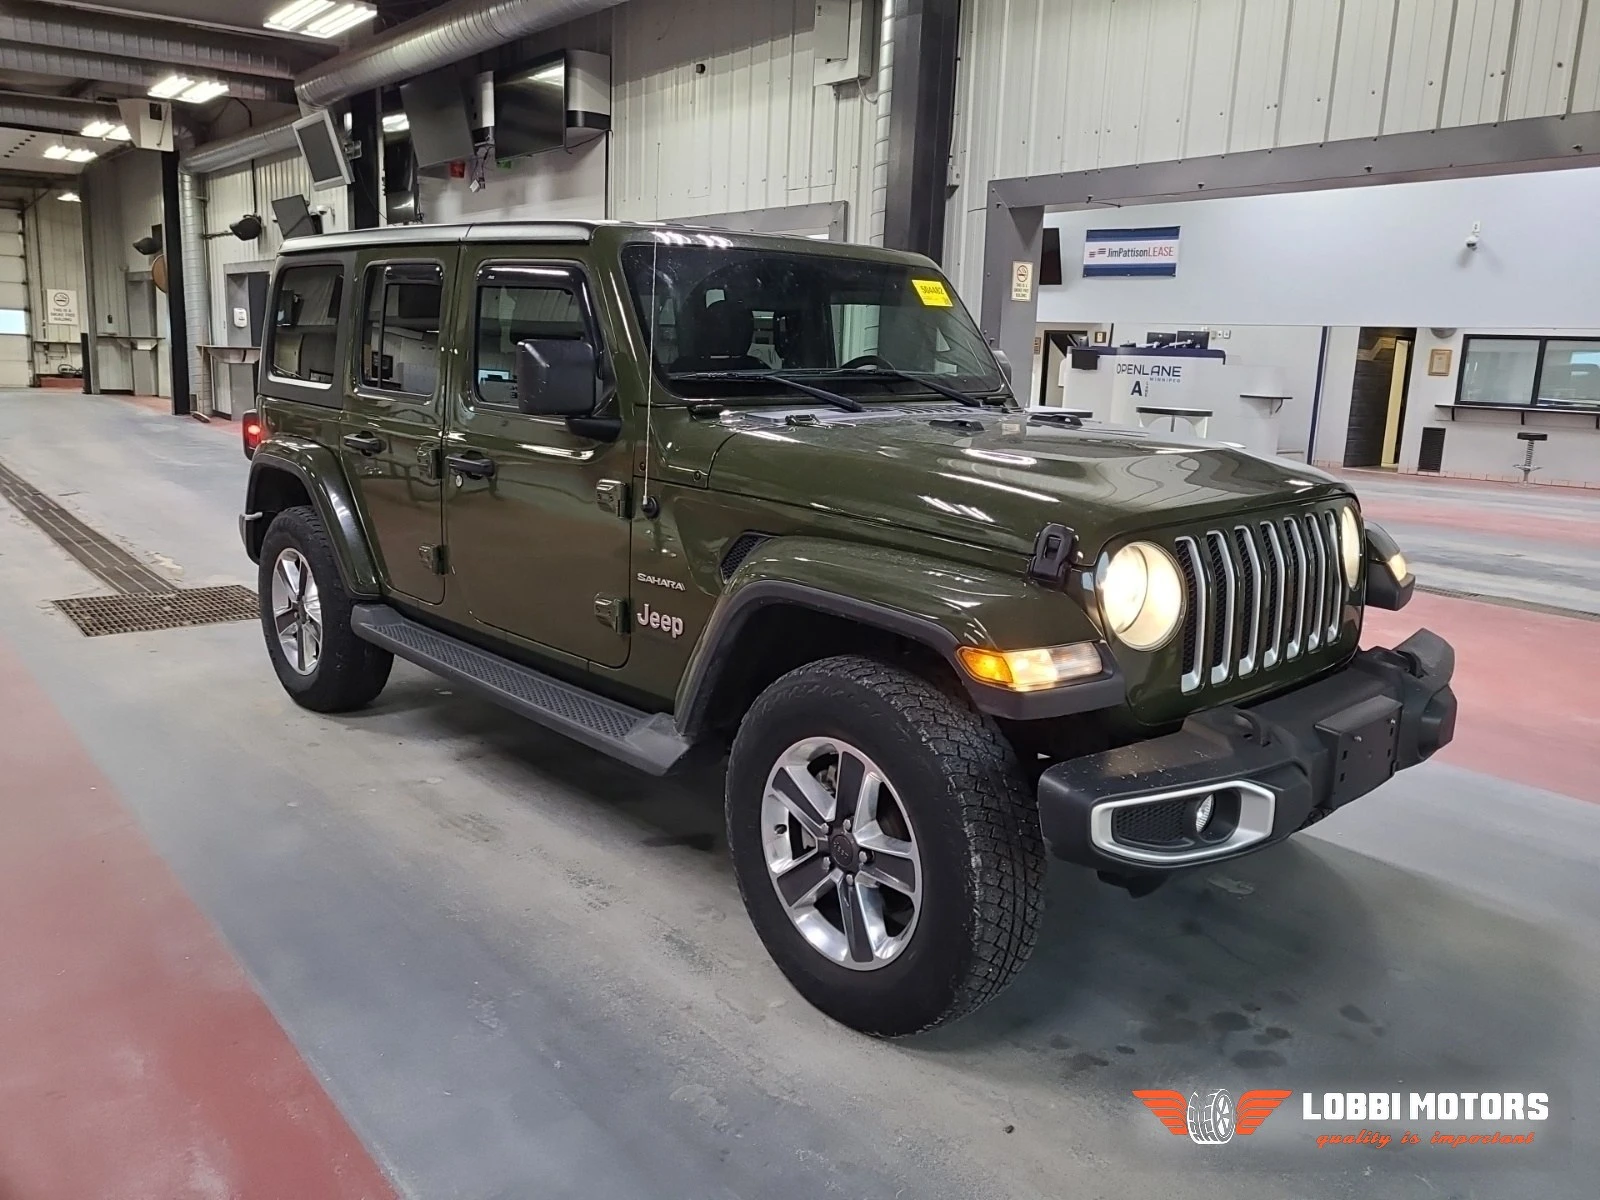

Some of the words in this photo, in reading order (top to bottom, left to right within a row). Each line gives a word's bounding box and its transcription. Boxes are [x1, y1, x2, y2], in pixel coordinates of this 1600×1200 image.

[1106, 246, 1174, 258] JimPattisonLEASE
[1116, 363, 1182, 377] OPENLANE
[1130, 380, 1143, 397] A
[636, 572, 686, 591] SAHARA
[636, 603, 684, 639] Jeep
